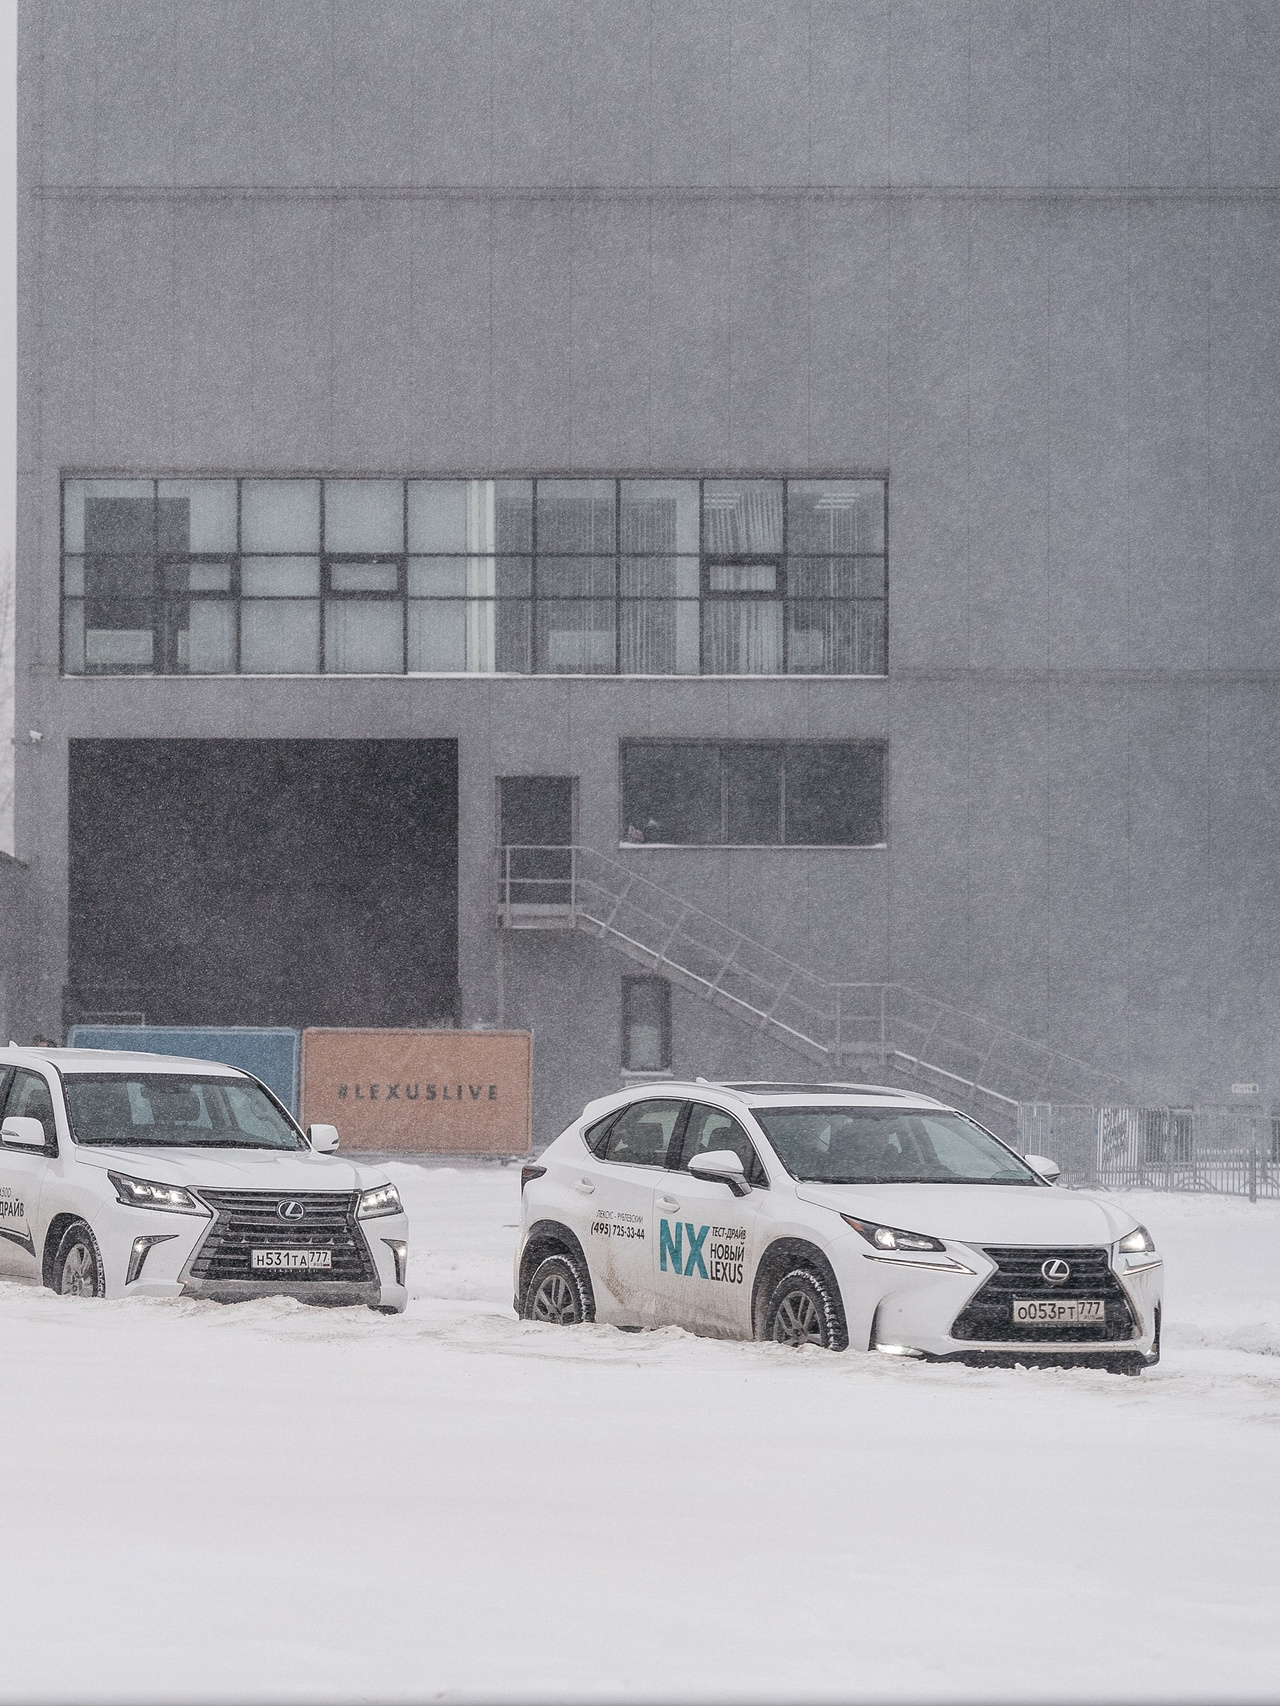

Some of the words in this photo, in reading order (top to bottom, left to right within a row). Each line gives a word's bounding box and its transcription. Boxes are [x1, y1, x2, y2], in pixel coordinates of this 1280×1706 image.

[337, 1083, 498, 1101] #LEXUSLIVE
[590, 1221, 611, 1237] (495)
[612, 1224, 645, 1240] 725-33-44
[712, 1226, 747, 1240] ТЕСТ-ДРАЙВ
[309, 1251, 328, 1262] 777
[660, 1218, 711, 1279] NX
[710, 1242, 745, 1262] НОВЫЙ
[710, 1261, 744, 1284] LEXUS
[1078, 1302, 1101, 1315] 777
